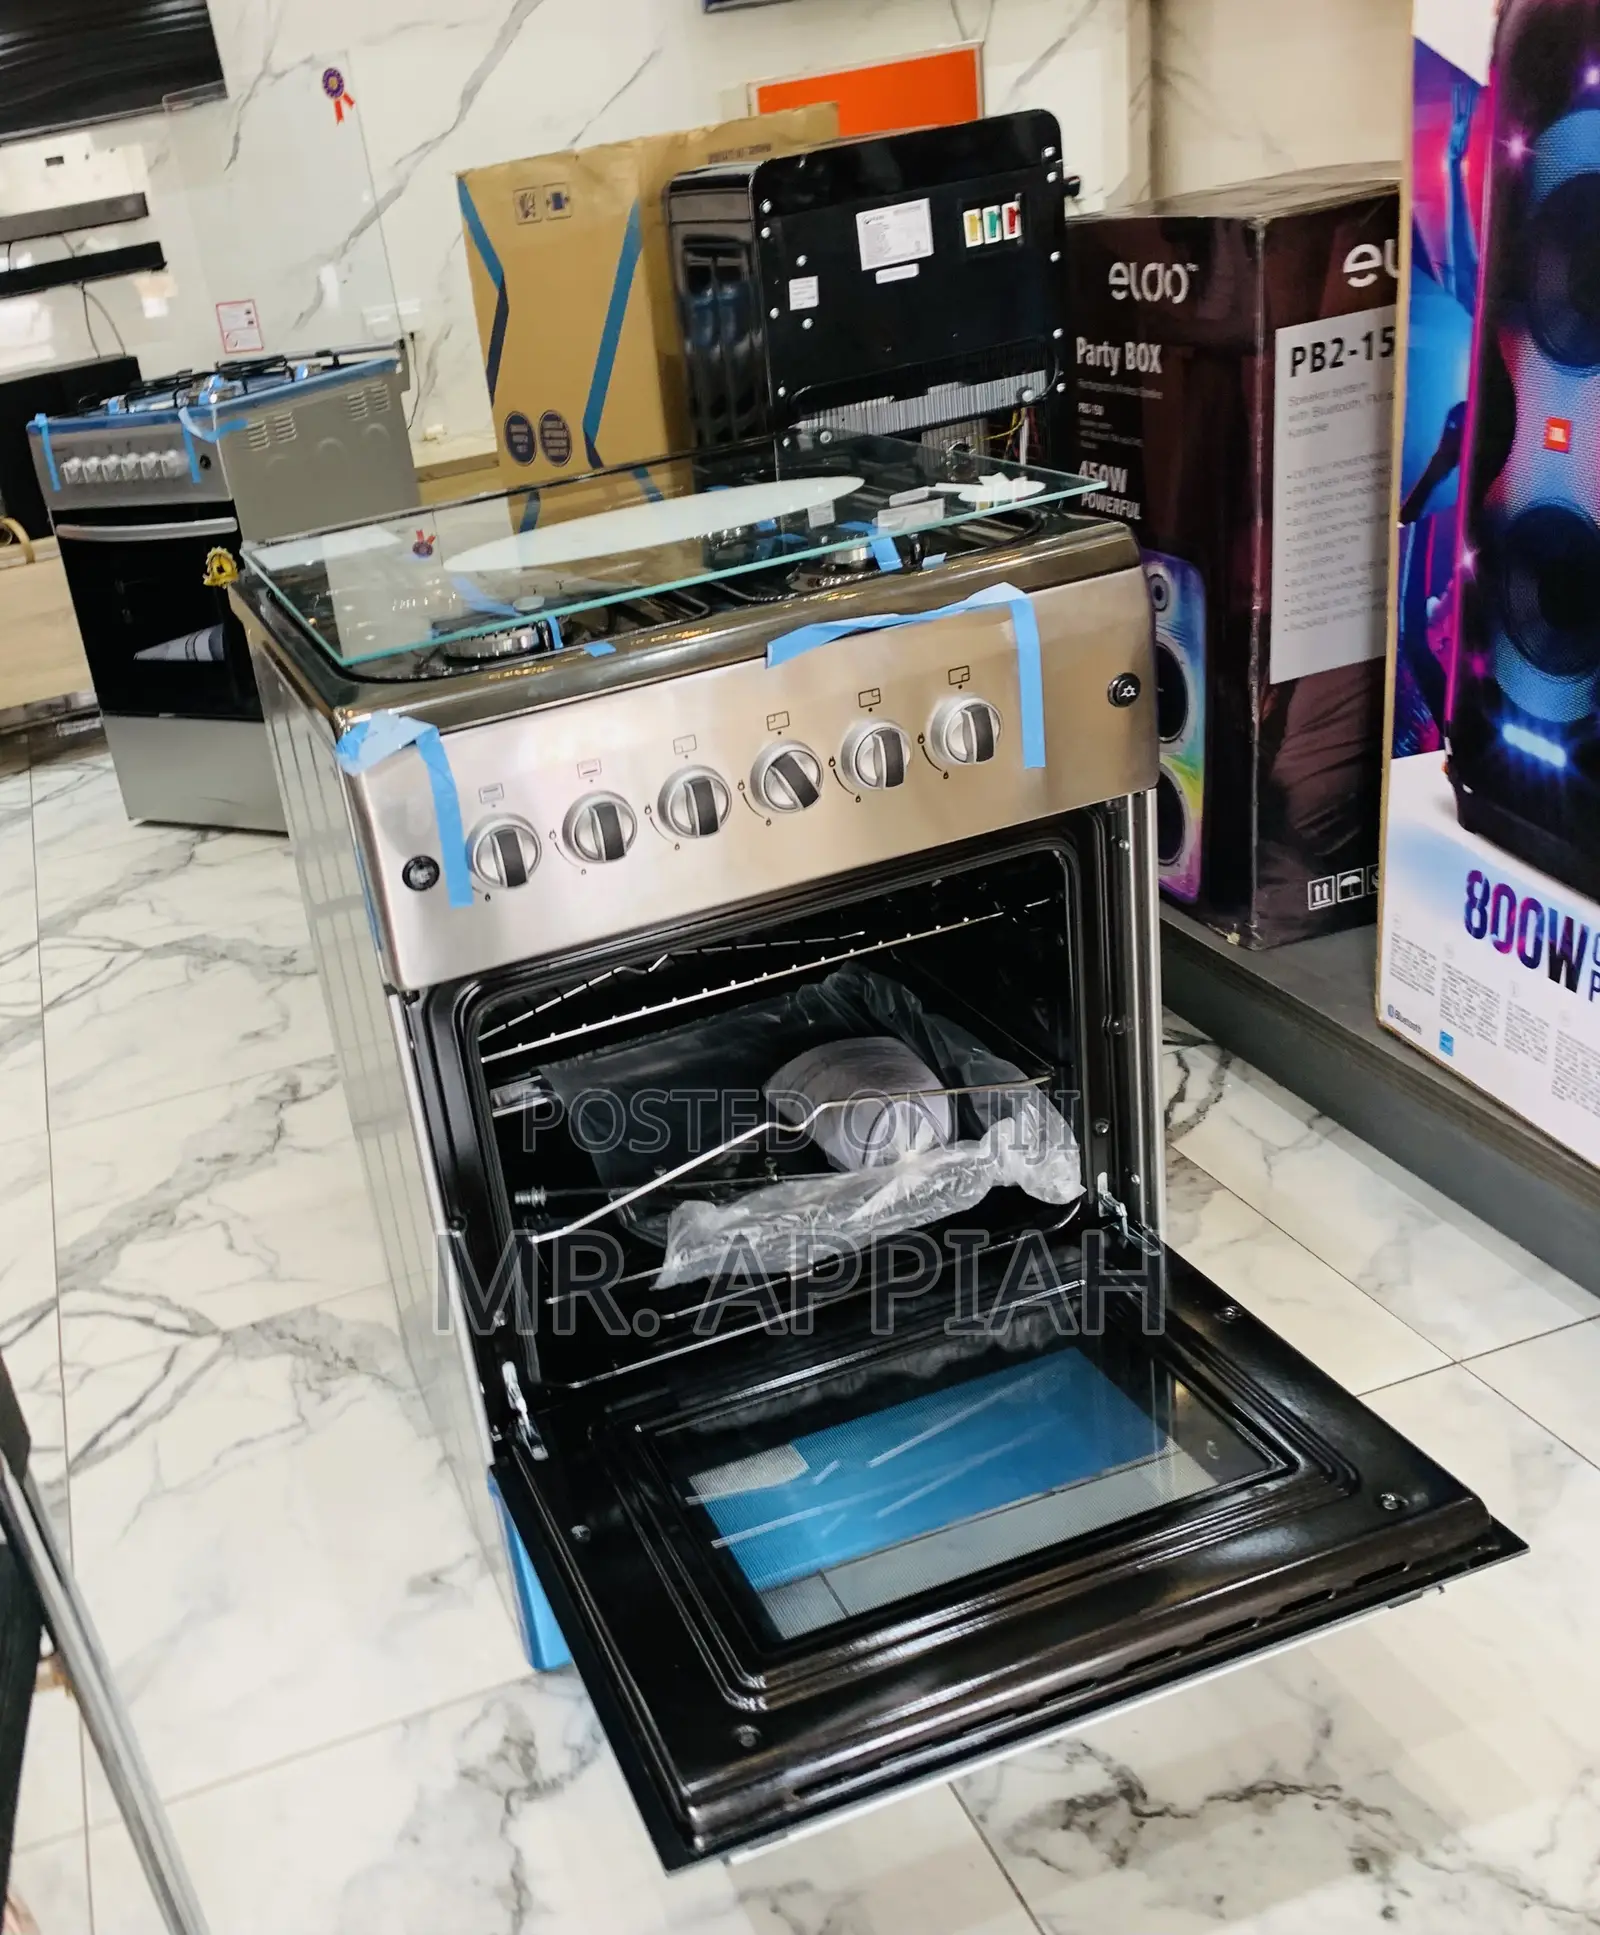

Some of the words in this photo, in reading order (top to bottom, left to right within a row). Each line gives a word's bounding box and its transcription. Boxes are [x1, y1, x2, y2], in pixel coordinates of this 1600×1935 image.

[1076, 336, 1121, 376] Party
[1125, 341, 1162, 374] BOX
[1081, 492, 1142, 520] POWERFUL
[1464, 869, 1590, 994] 800W
